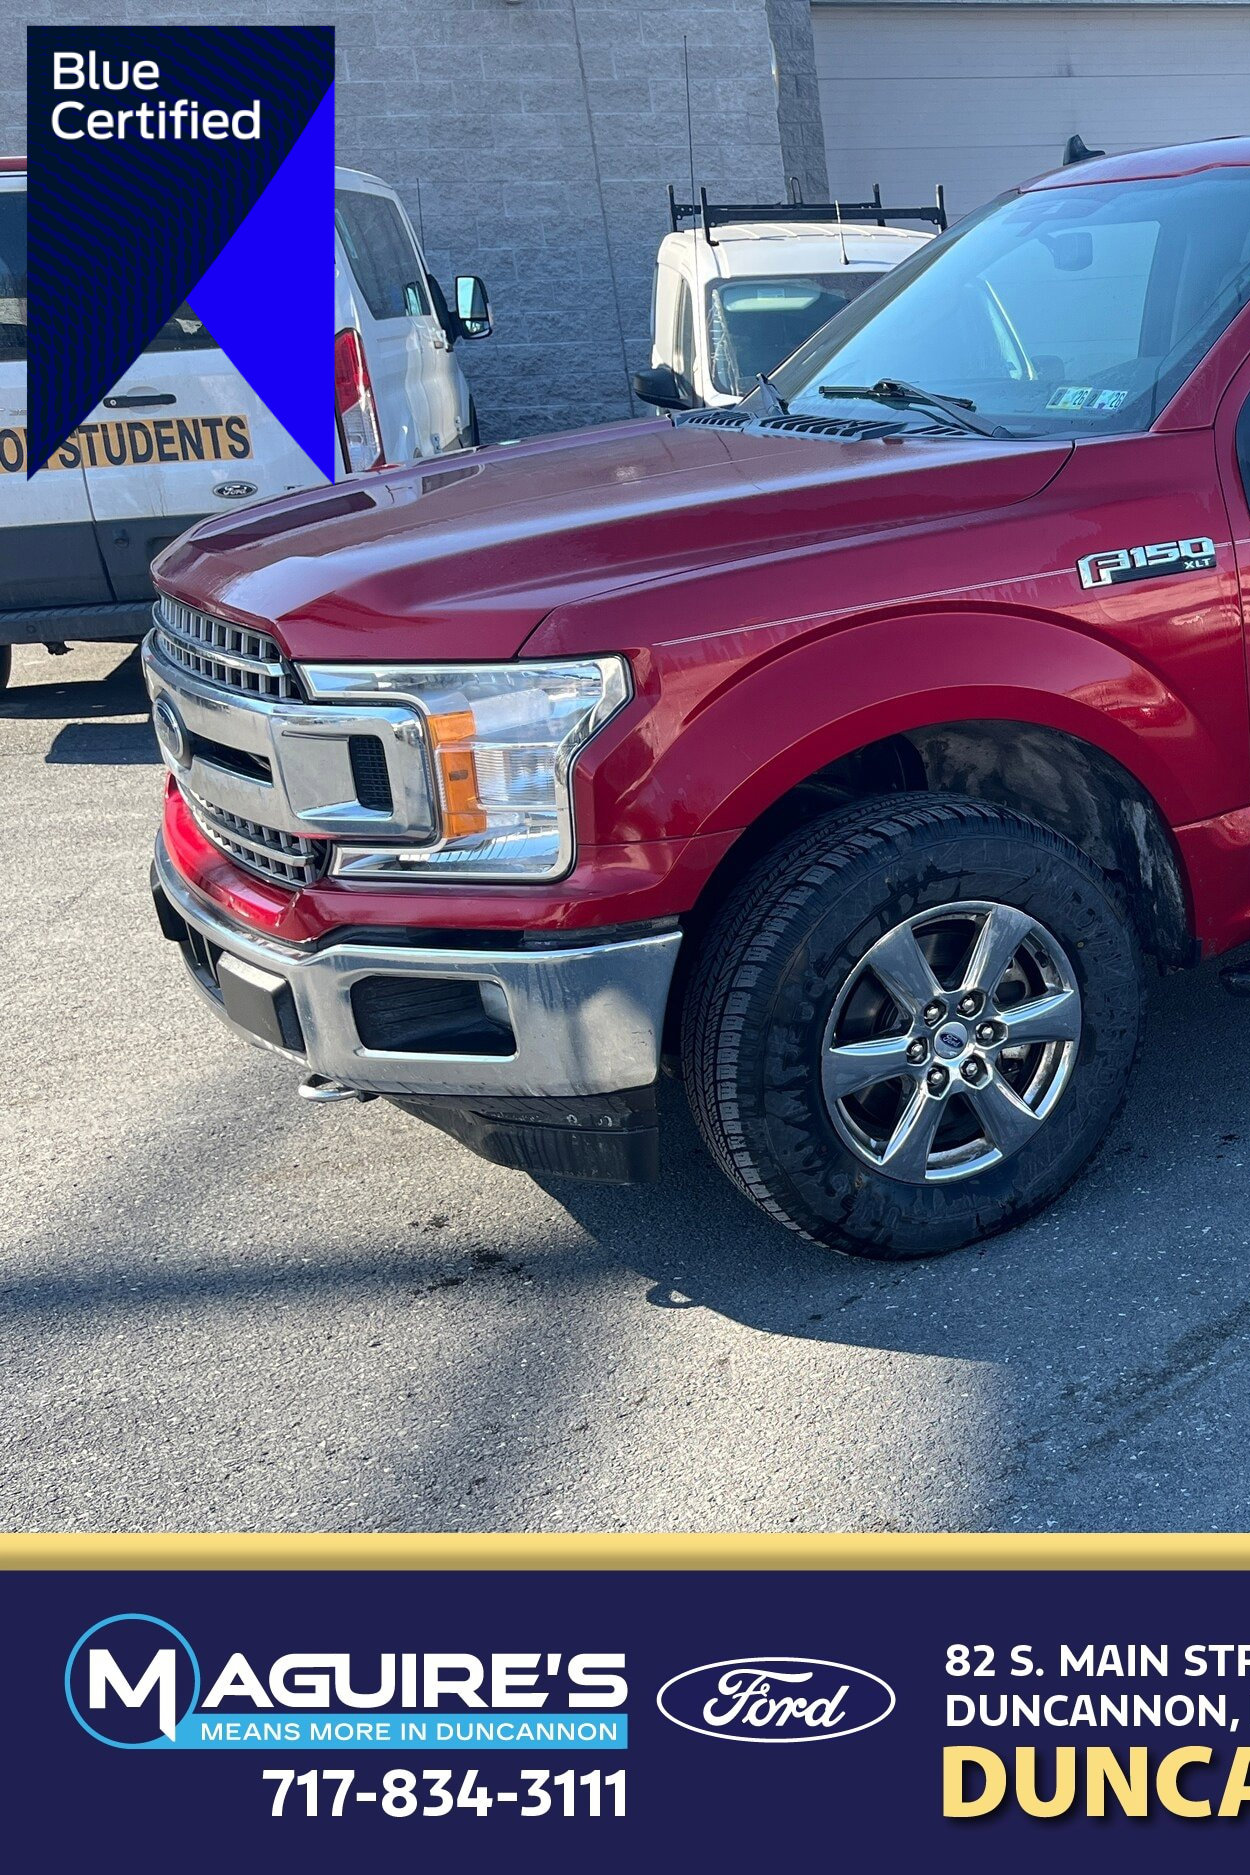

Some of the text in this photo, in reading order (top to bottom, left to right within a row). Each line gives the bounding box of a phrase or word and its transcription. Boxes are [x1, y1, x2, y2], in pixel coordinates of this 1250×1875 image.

[58, 415, 250, 469] STUDENTS
[1184, 557, 1212, 570] XLT
[942, 1034, 962, 1047] Ford
